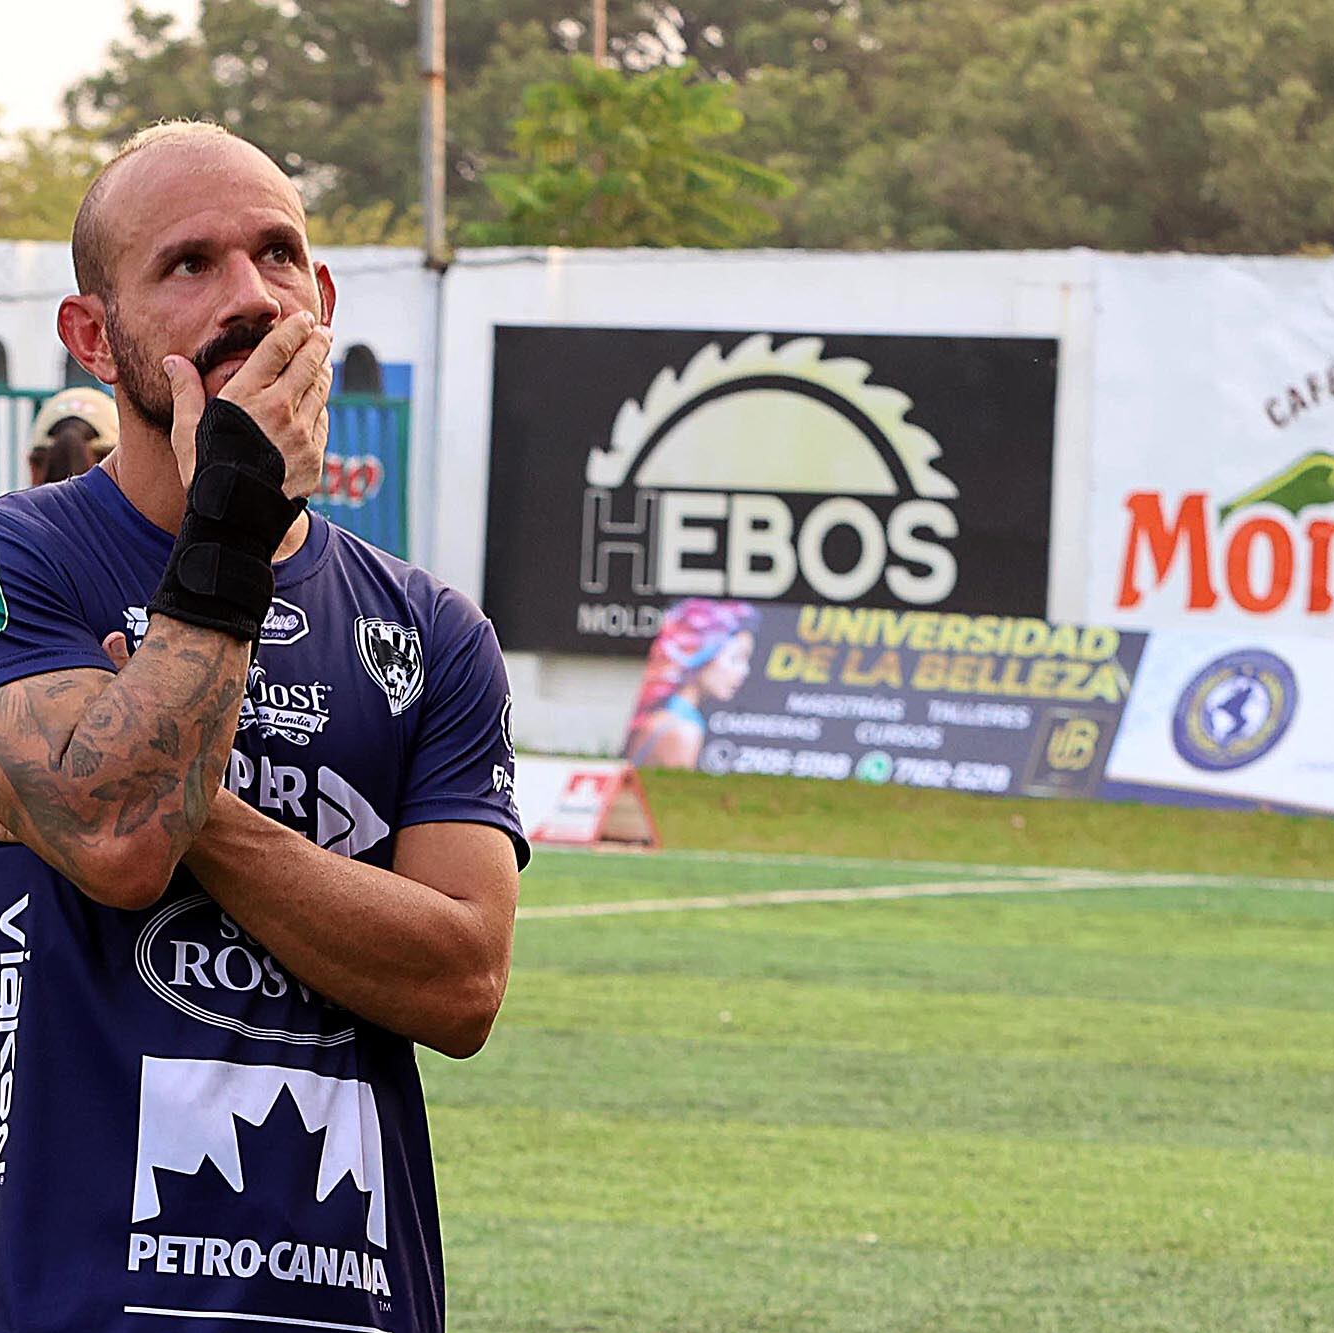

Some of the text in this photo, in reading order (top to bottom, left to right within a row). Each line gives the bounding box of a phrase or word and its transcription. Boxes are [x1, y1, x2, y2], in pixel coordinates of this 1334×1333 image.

[579, 487, 960, 605] HEBOS
[797, 606, 1121, 662] UNIVERSIDAD
[253, 681, 329, 715] JOSÉ
[766, 643, 1123, 704] DE LA BELLEZA
[274, 712, 312, 728] familia
[168, 939, 310, 1003] ROS
